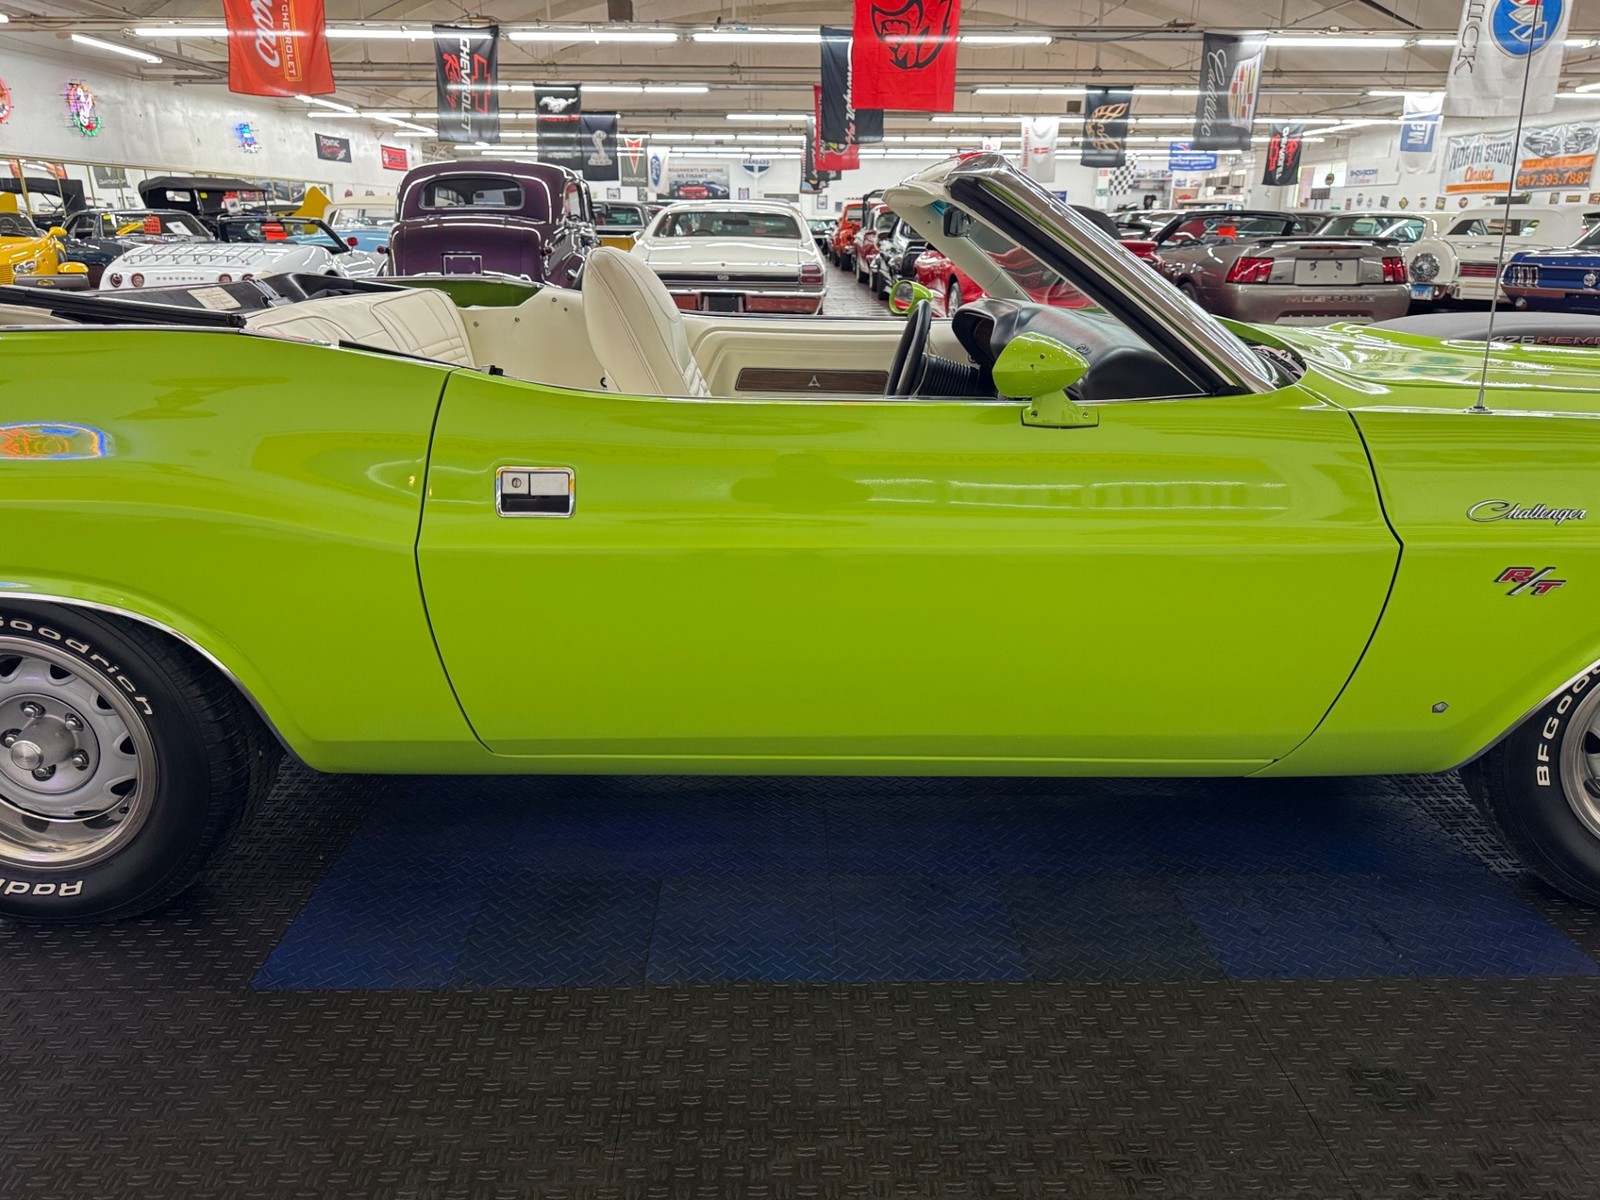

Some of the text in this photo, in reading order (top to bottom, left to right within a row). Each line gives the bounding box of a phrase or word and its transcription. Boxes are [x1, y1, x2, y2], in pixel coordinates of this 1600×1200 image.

[281, 4, 297, 76] CHEVROLET
[460, 37, 472, 135] CHEVROLET
[1201, 48, 1228, 137] Cadillac
[1516, 170, 1592, 188] 847.393.7887
[1286, 294, 1376, 304] MUSTANG
[1466, 498, 1588, 527] Challenger
[1493, 566, 1567, 596] R/T
